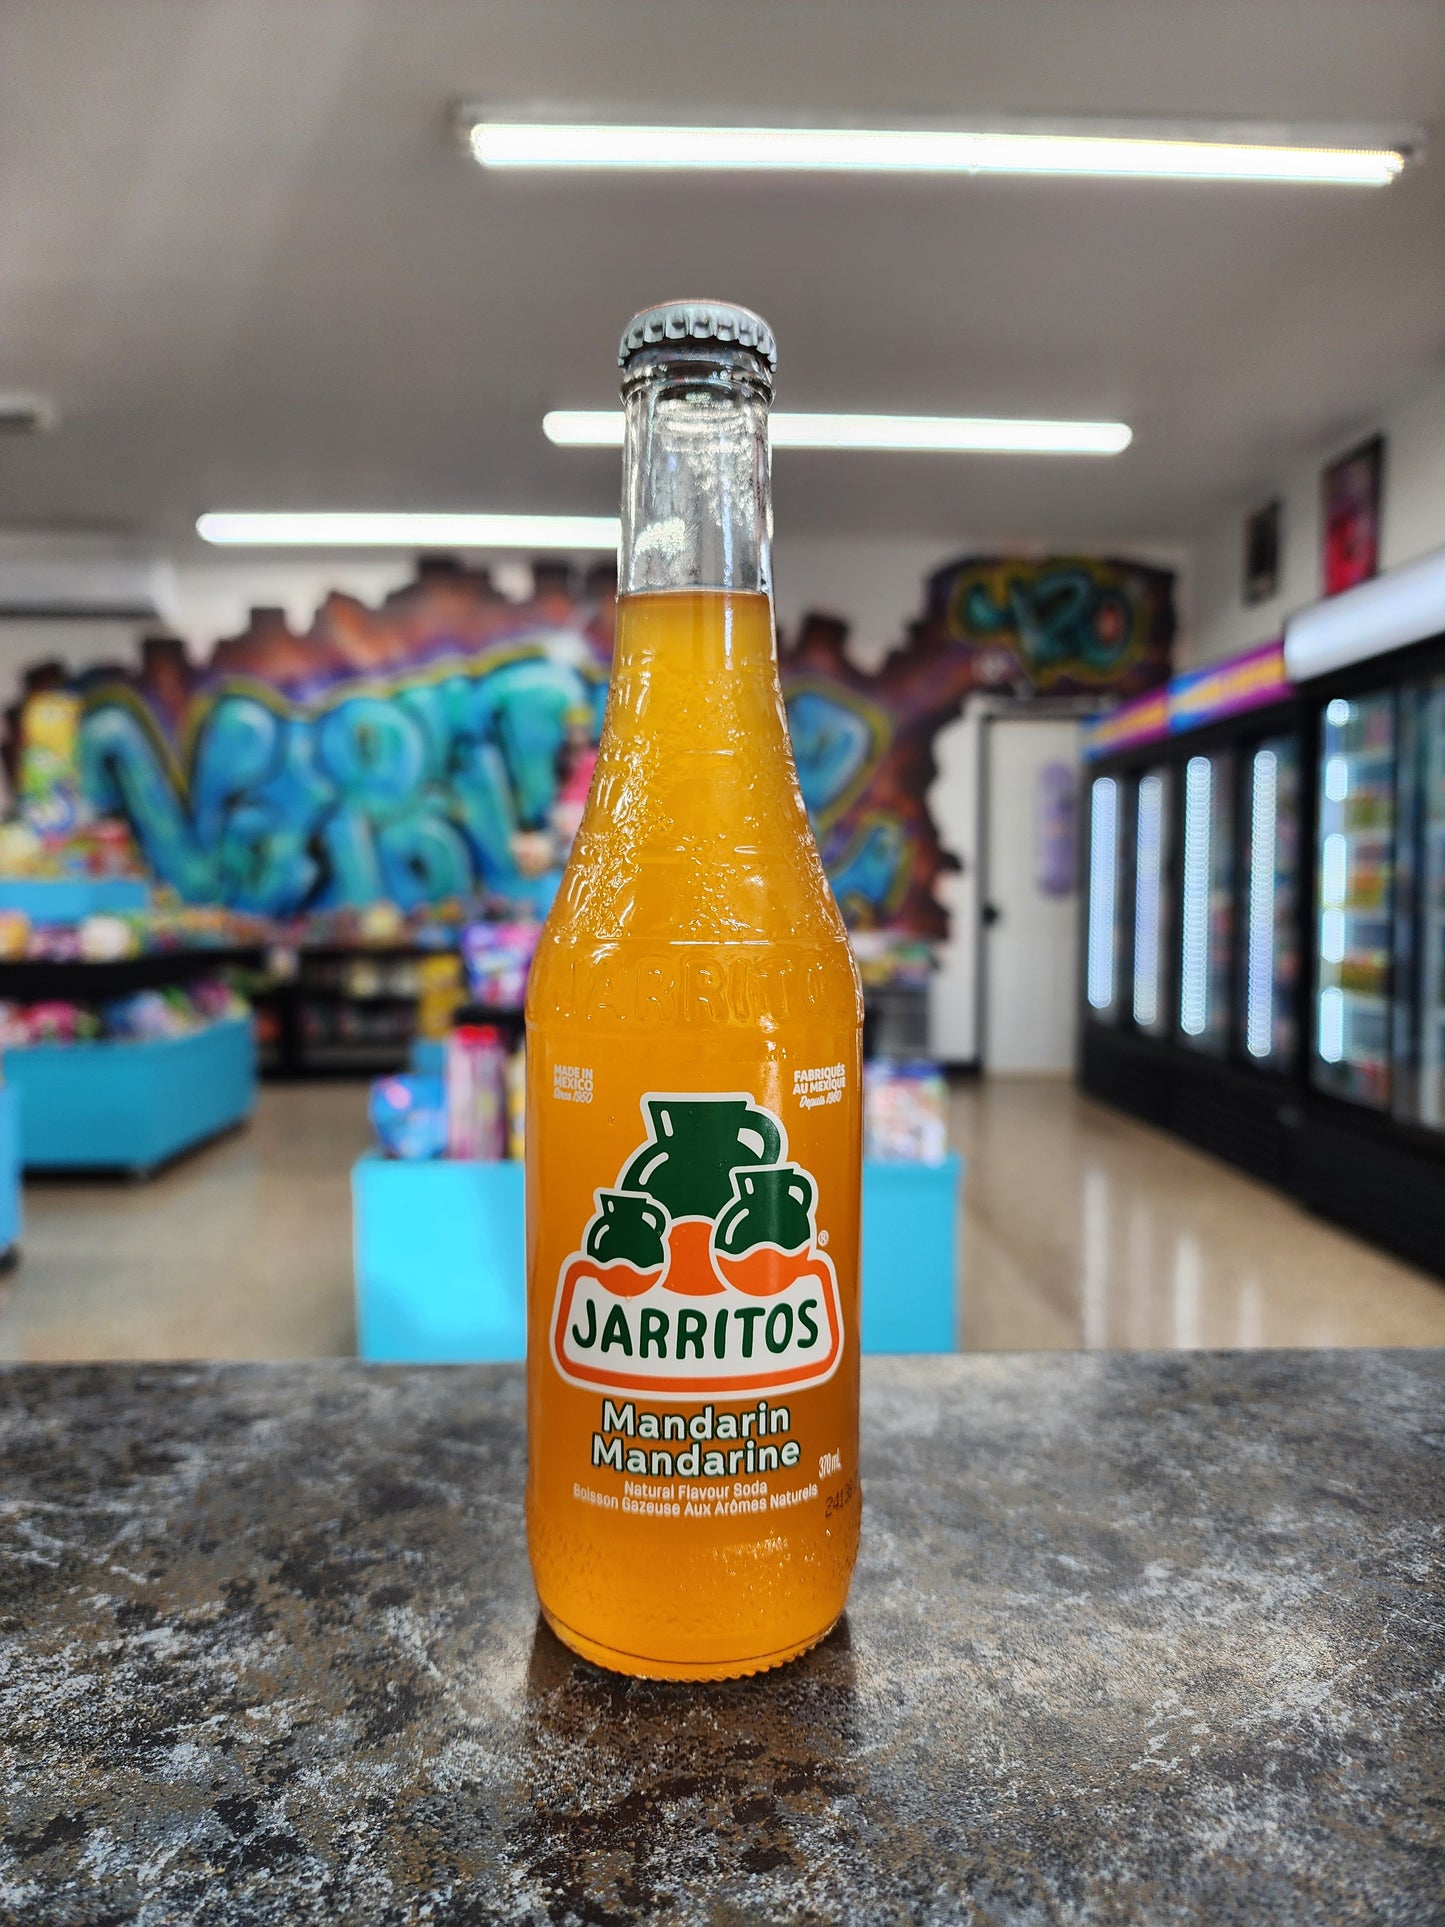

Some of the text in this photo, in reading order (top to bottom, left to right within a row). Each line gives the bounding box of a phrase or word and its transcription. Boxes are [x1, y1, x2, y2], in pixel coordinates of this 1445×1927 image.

[553, 1064, 594, 1081] MADE IN
[553, 1075, 594, 1092] MEXICO
[794, 1062, 846, 1083] FABRIQUÉS
[792, 1076, 847, 1095] AU MEXIQUE
[572, 1298, 819, 1360] JARRITOS
[602, 1398, 792, 1441] Mandarin
[592, 1432, 802, 1478] Mandarine
[573, 1482, 819, 1518] Boisson Gazeuse Aux Arômes Naturels
[624, 1479, 768, 1501] Natural Flavour Soda
